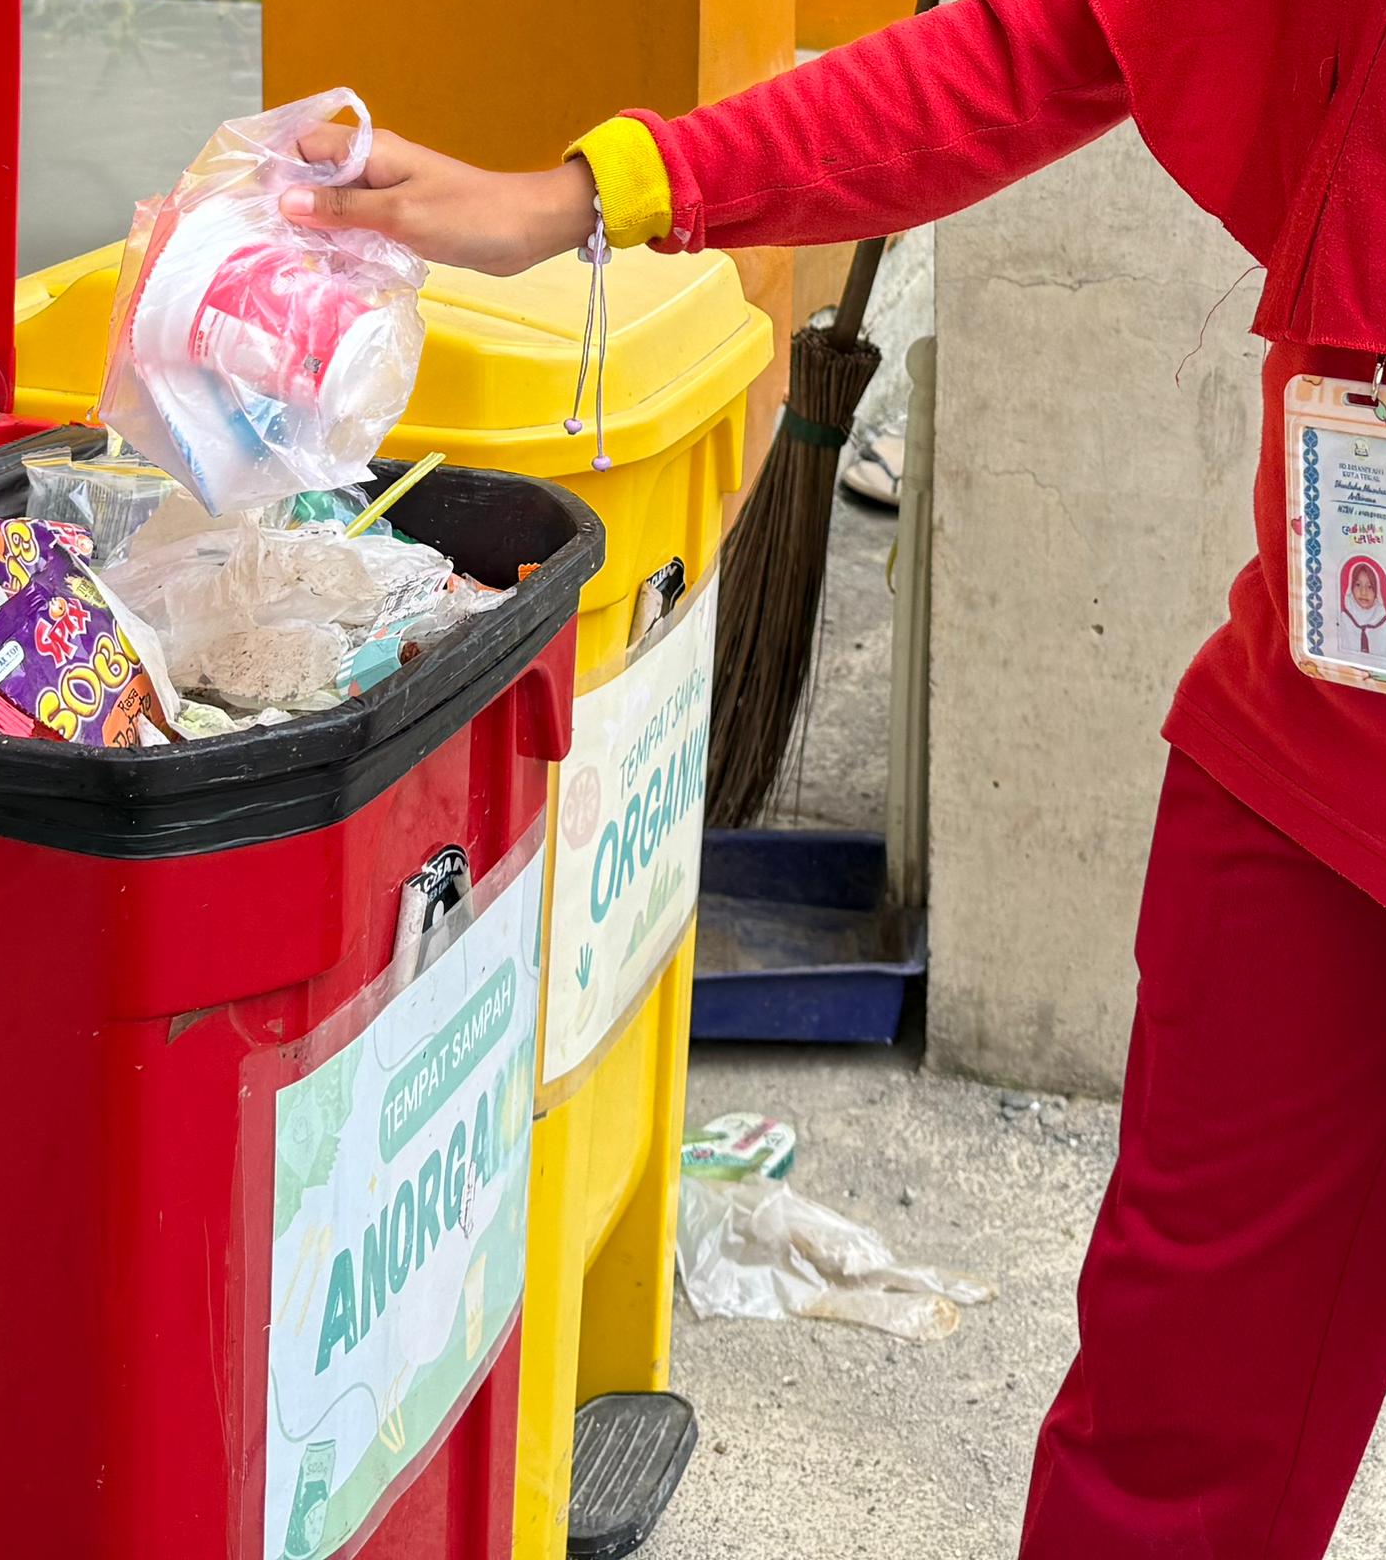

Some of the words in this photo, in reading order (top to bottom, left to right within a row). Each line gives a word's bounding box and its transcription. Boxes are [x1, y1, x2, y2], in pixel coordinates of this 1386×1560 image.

[117, 687, 140, 713] Rasa
[619, 695, 675, 800] TEMPAT
[383, 1046, 450, 1142] TEMPAT
[451, 973, 513, 1069] SAMPAH
